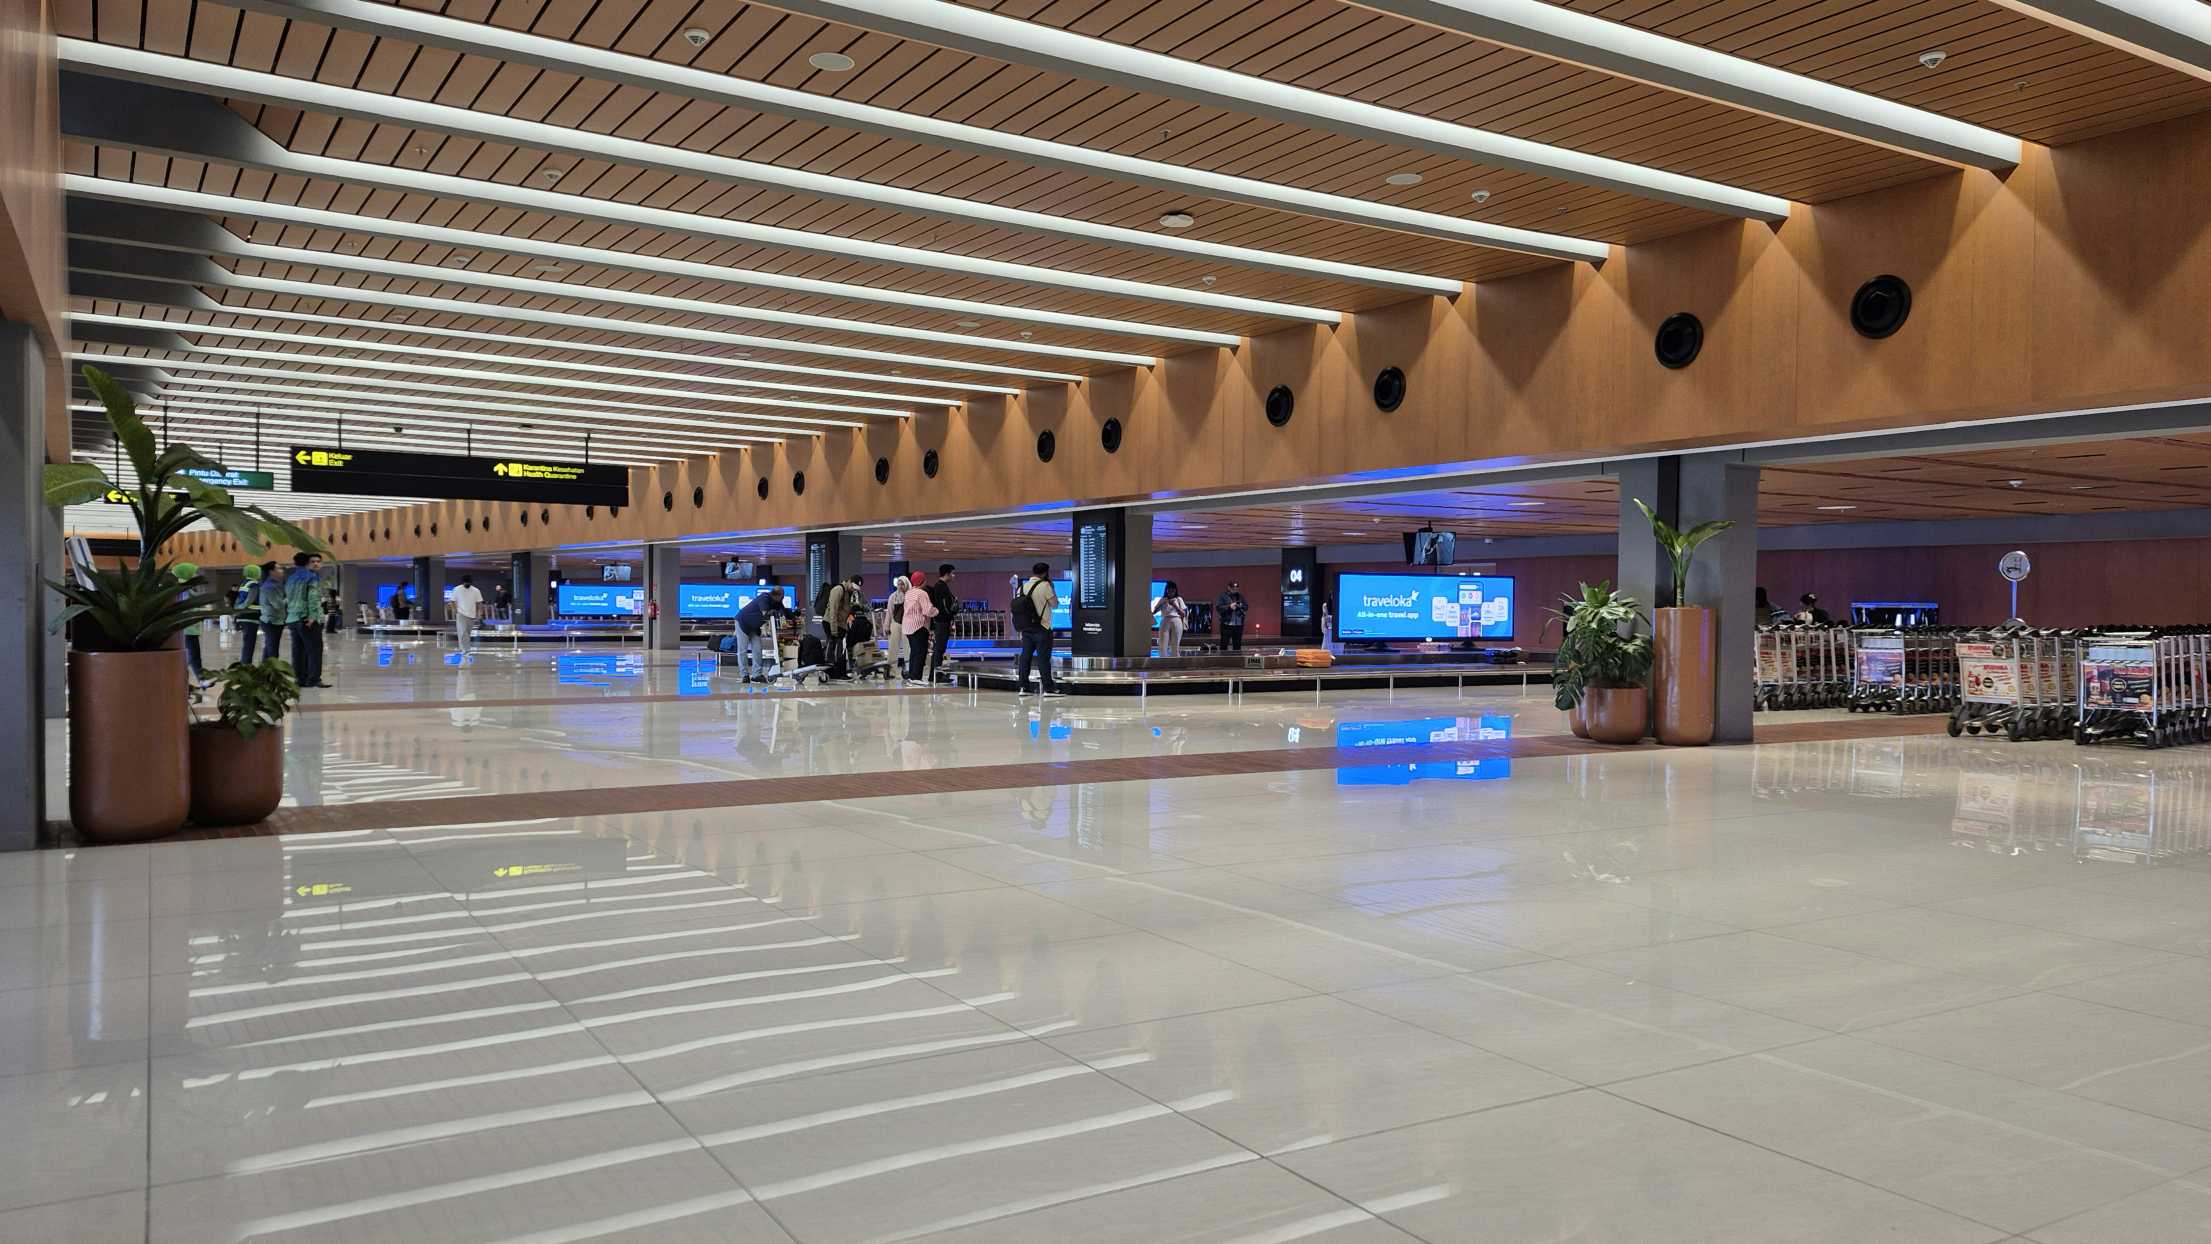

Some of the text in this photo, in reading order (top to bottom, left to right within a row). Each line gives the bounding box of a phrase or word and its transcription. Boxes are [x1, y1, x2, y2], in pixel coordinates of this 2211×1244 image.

[189, 468, 209, 477] Pintu
[233, 478, 249, 486] Exit
[1290, 569, 1303, 582] 04
[691, 594, 726, 602] traveloka
[1363, 594, 1412, 607] traveloka
